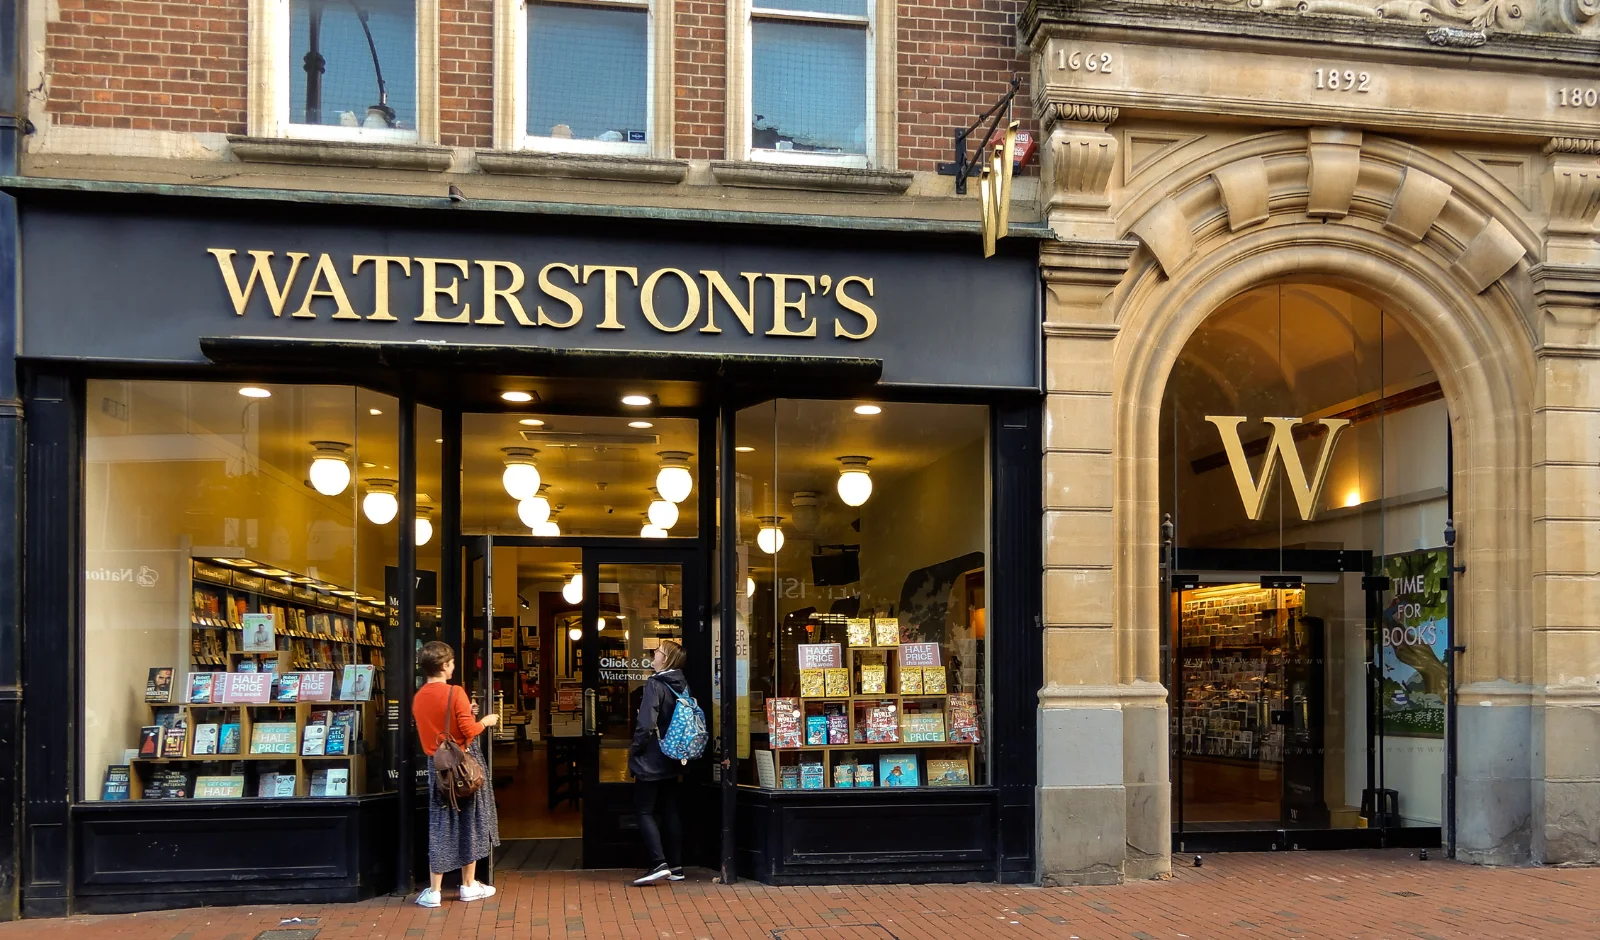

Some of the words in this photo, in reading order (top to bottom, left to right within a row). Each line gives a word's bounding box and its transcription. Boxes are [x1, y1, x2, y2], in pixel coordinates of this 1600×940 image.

[1057, 49, 1112, 73] 1662
[1314, 68, 1371, 93] 1892
[1558, 87, 1600, 107] 180
[207, 247, 878, 339] WATERSTONE'S
[1205, 415, 1350, 521] W
[1392, 574, 1425, 594] TIME
[1397, 603, 1421, 618] FOR
[1382, 626, 1436, 646] BOOKS
[806, 646, 833, 655] HALF
[904, 645, 931, 654] HALF
[806, 654, 834, 663] PRICE
[905, 653, 933, 661] PRICE
[600, 657, 628, 668] Click
[631, 658, 639, 668] &
[232, 675, 264, 684] HALF
[304, 673, 325, 682] ALF
[231, 683, 263, 692] PRICE
[302, 682, 325, 690] RICE
[911, 724, 937, 732] HALF
[261, 732, 290, 742] HALF
[910, 732, 939, 741] PRICE
[258, 743, 291, 753] PRICE
[203, 787, 233, 797] HALF
